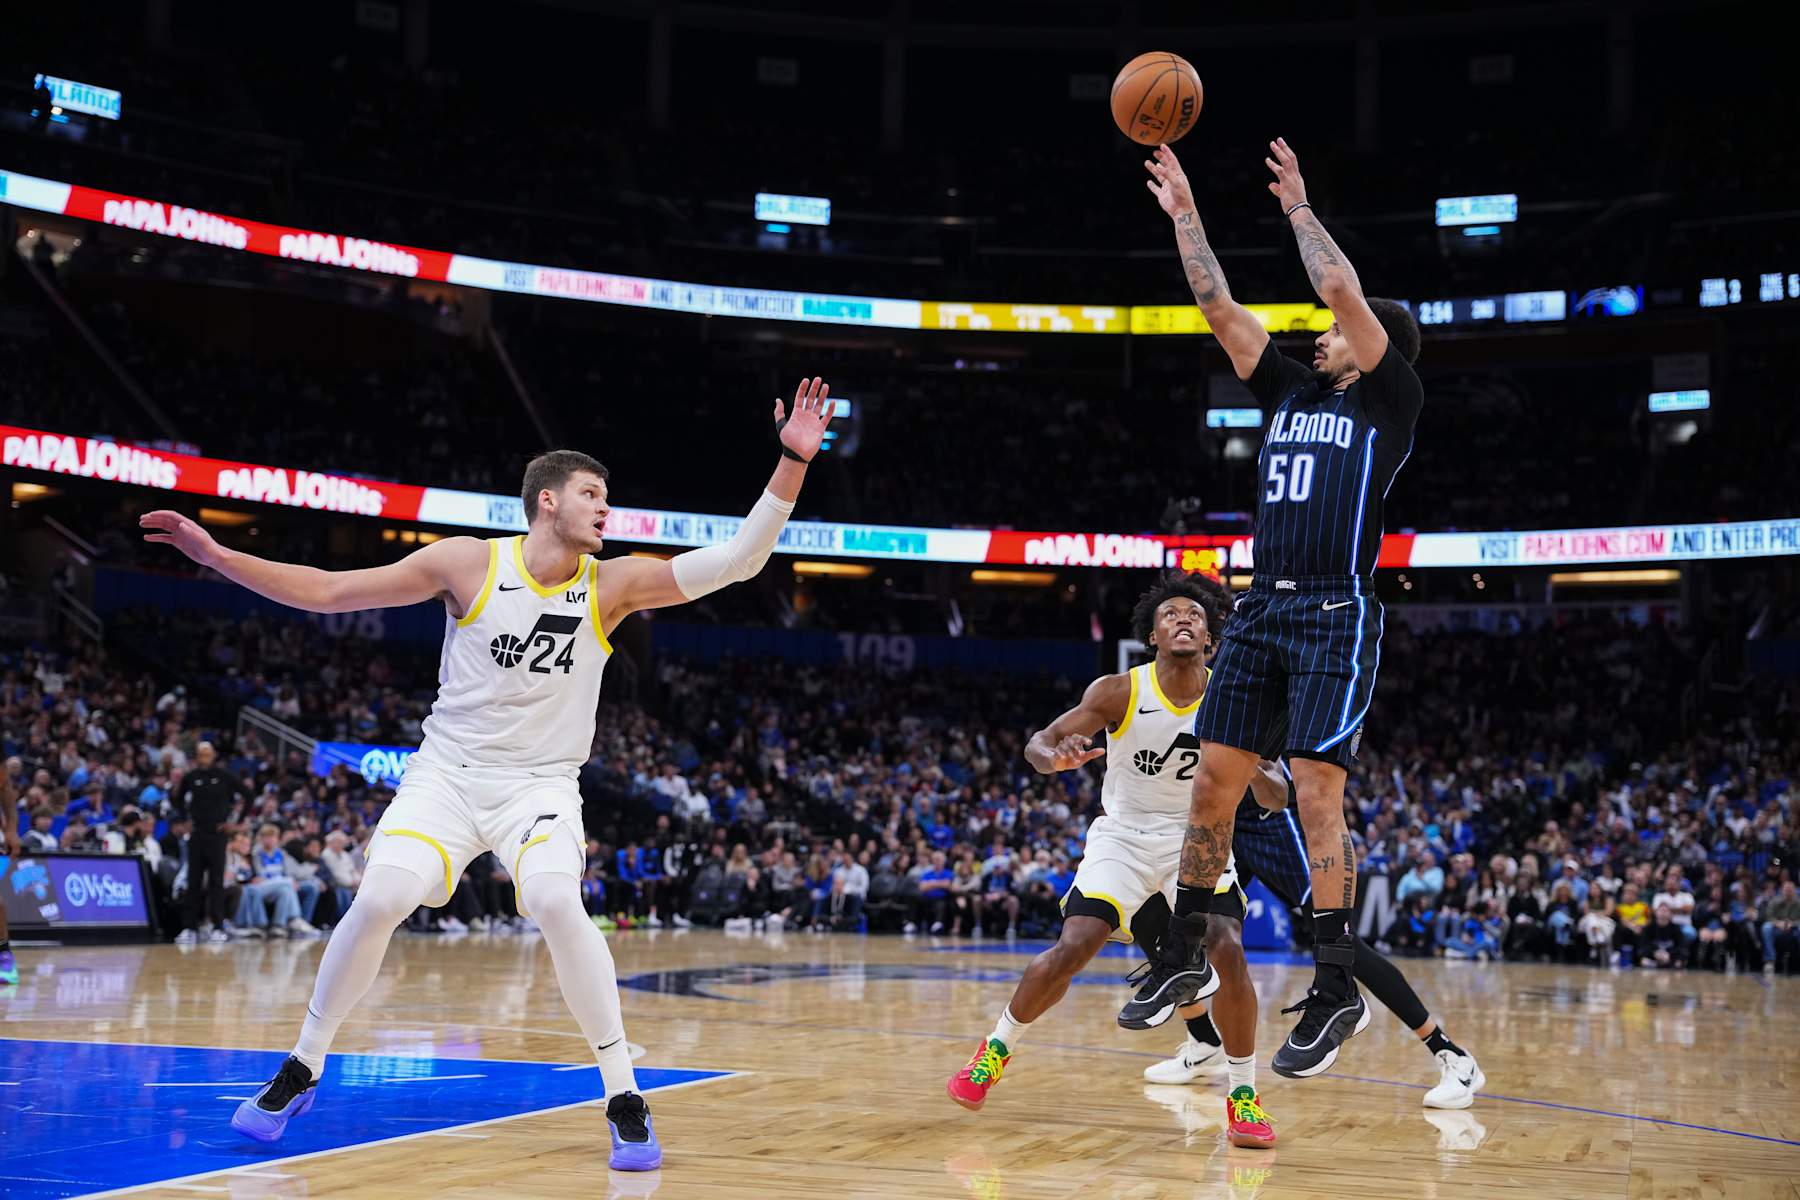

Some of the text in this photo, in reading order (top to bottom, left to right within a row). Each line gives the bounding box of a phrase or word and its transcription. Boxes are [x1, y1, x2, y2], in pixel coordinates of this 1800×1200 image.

[1266, 454, 1315, 503] 50
[1671, 528, 1706, 554] AND
[1712, 527, 1764, 551] ENTER
[1275, 580, 1297, 590] MAGIC
[529, 634, 577, 674] 24
[837, 632, 916, 678] 109
